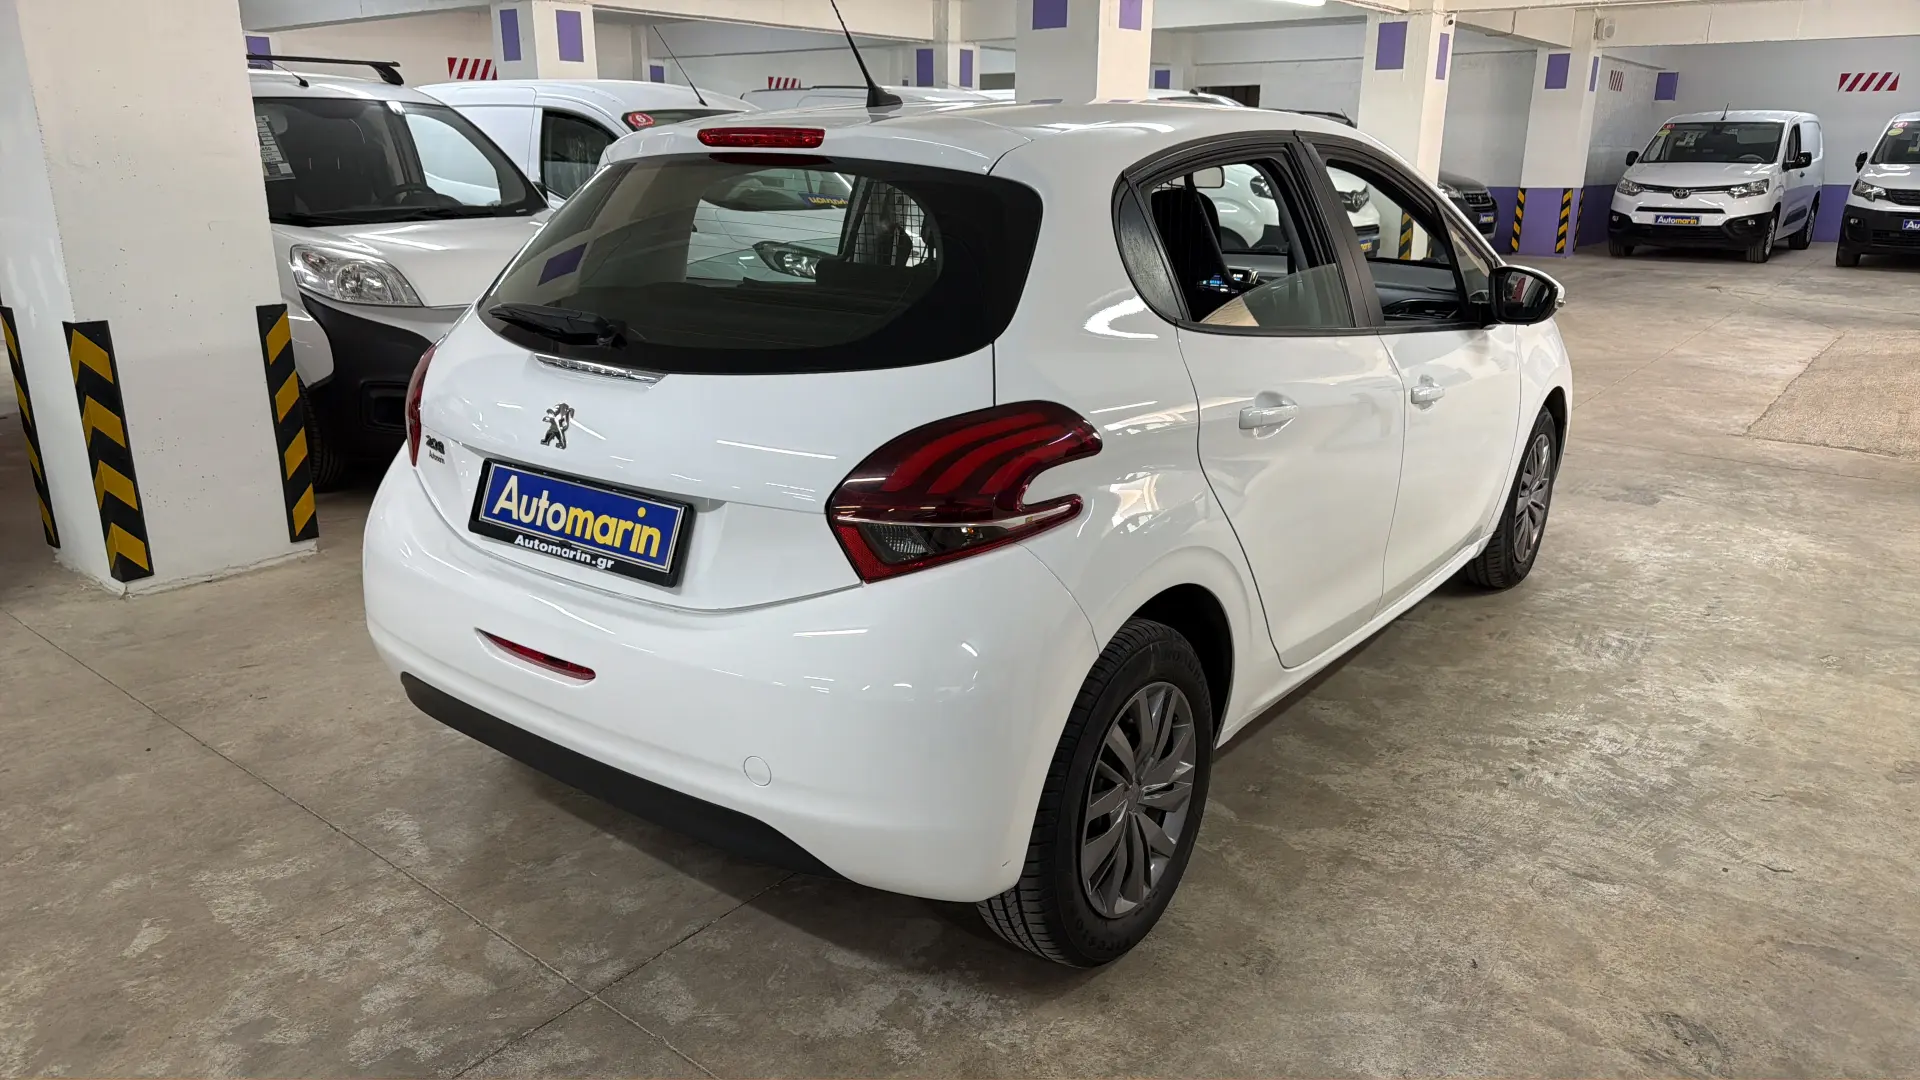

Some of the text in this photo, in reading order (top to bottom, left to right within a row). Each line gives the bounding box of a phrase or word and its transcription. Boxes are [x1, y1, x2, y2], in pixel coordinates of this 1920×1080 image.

[1657, 215, 1697, 225] Automarin
[492, 475, 661, 558] Automarin
[514, 534, 615, 570] Automarin.gr
